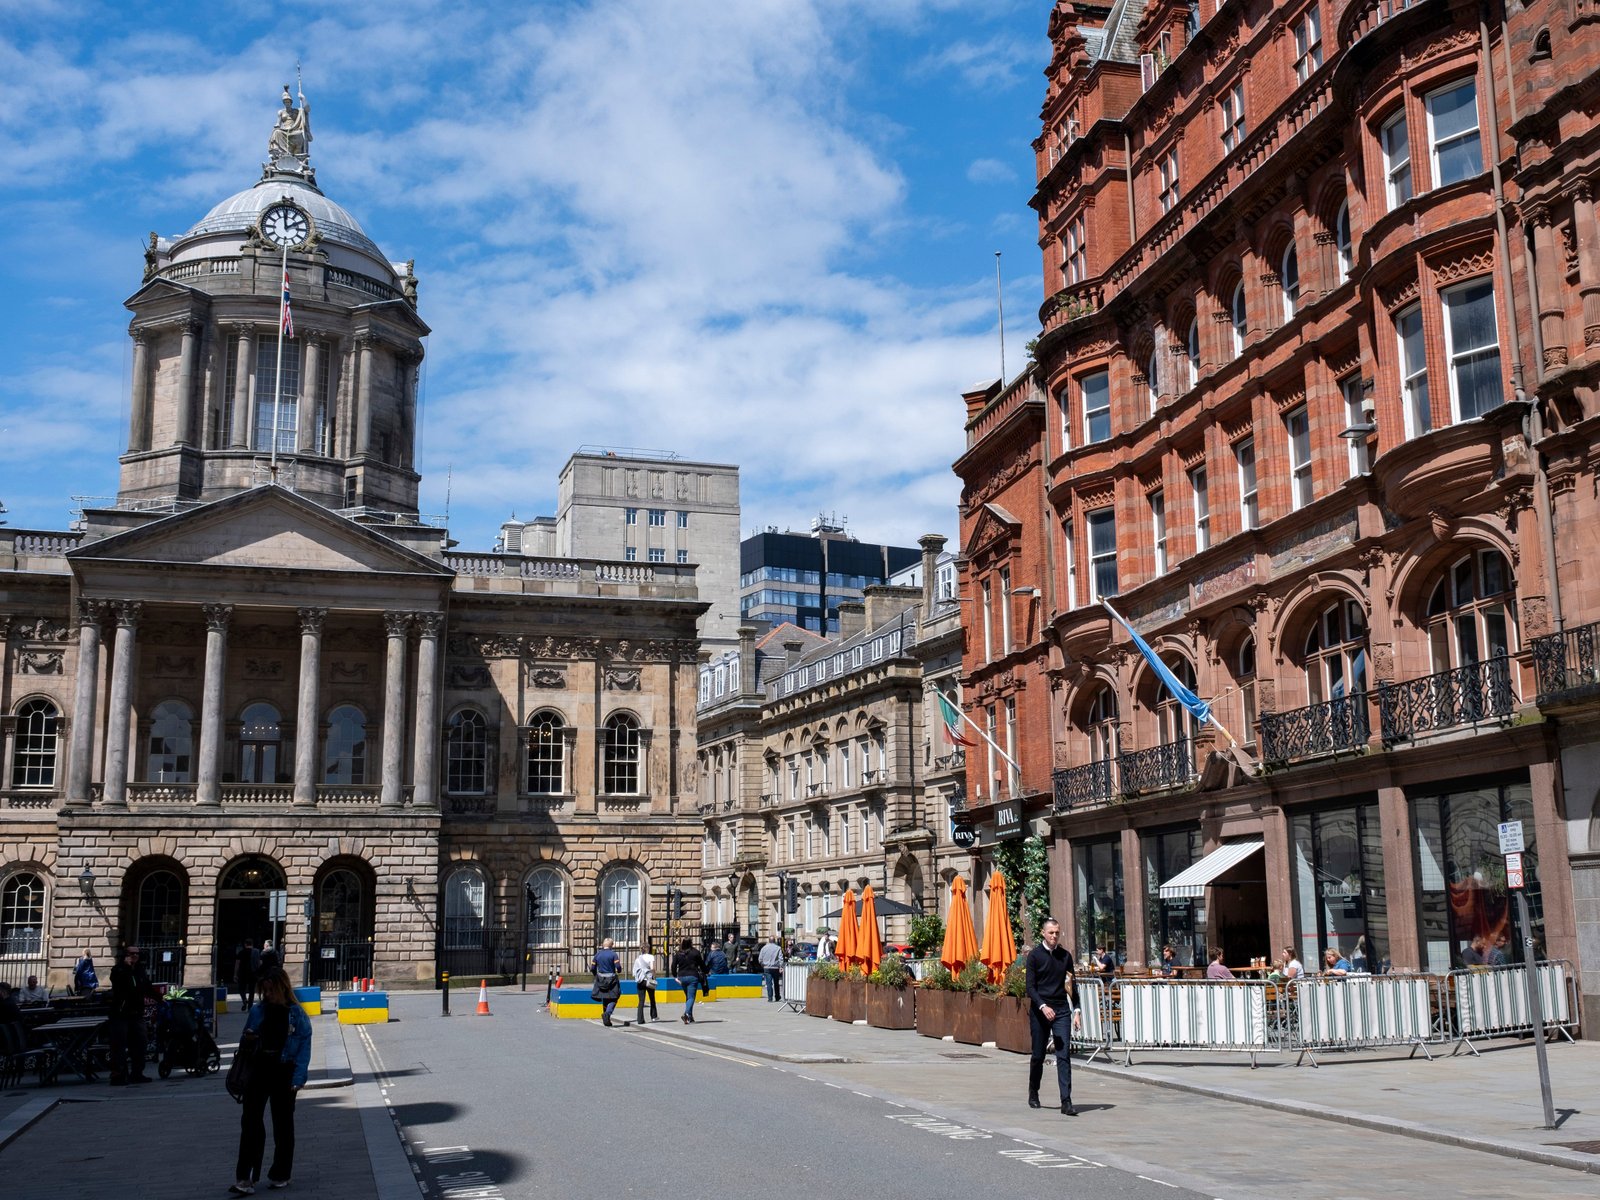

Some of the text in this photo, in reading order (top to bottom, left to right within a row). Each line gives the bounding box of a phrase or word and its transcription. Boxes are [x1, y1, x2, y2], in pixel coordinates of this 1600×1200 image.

[998, 808, 1014, 826] RIVA
[955, 832, 974, 840] RIVA
[884, 1113, 993, 1140] LOADING
[998, 1149, 1097, 1169] ONLY
[435, 1171, 506, 1200] ADING
